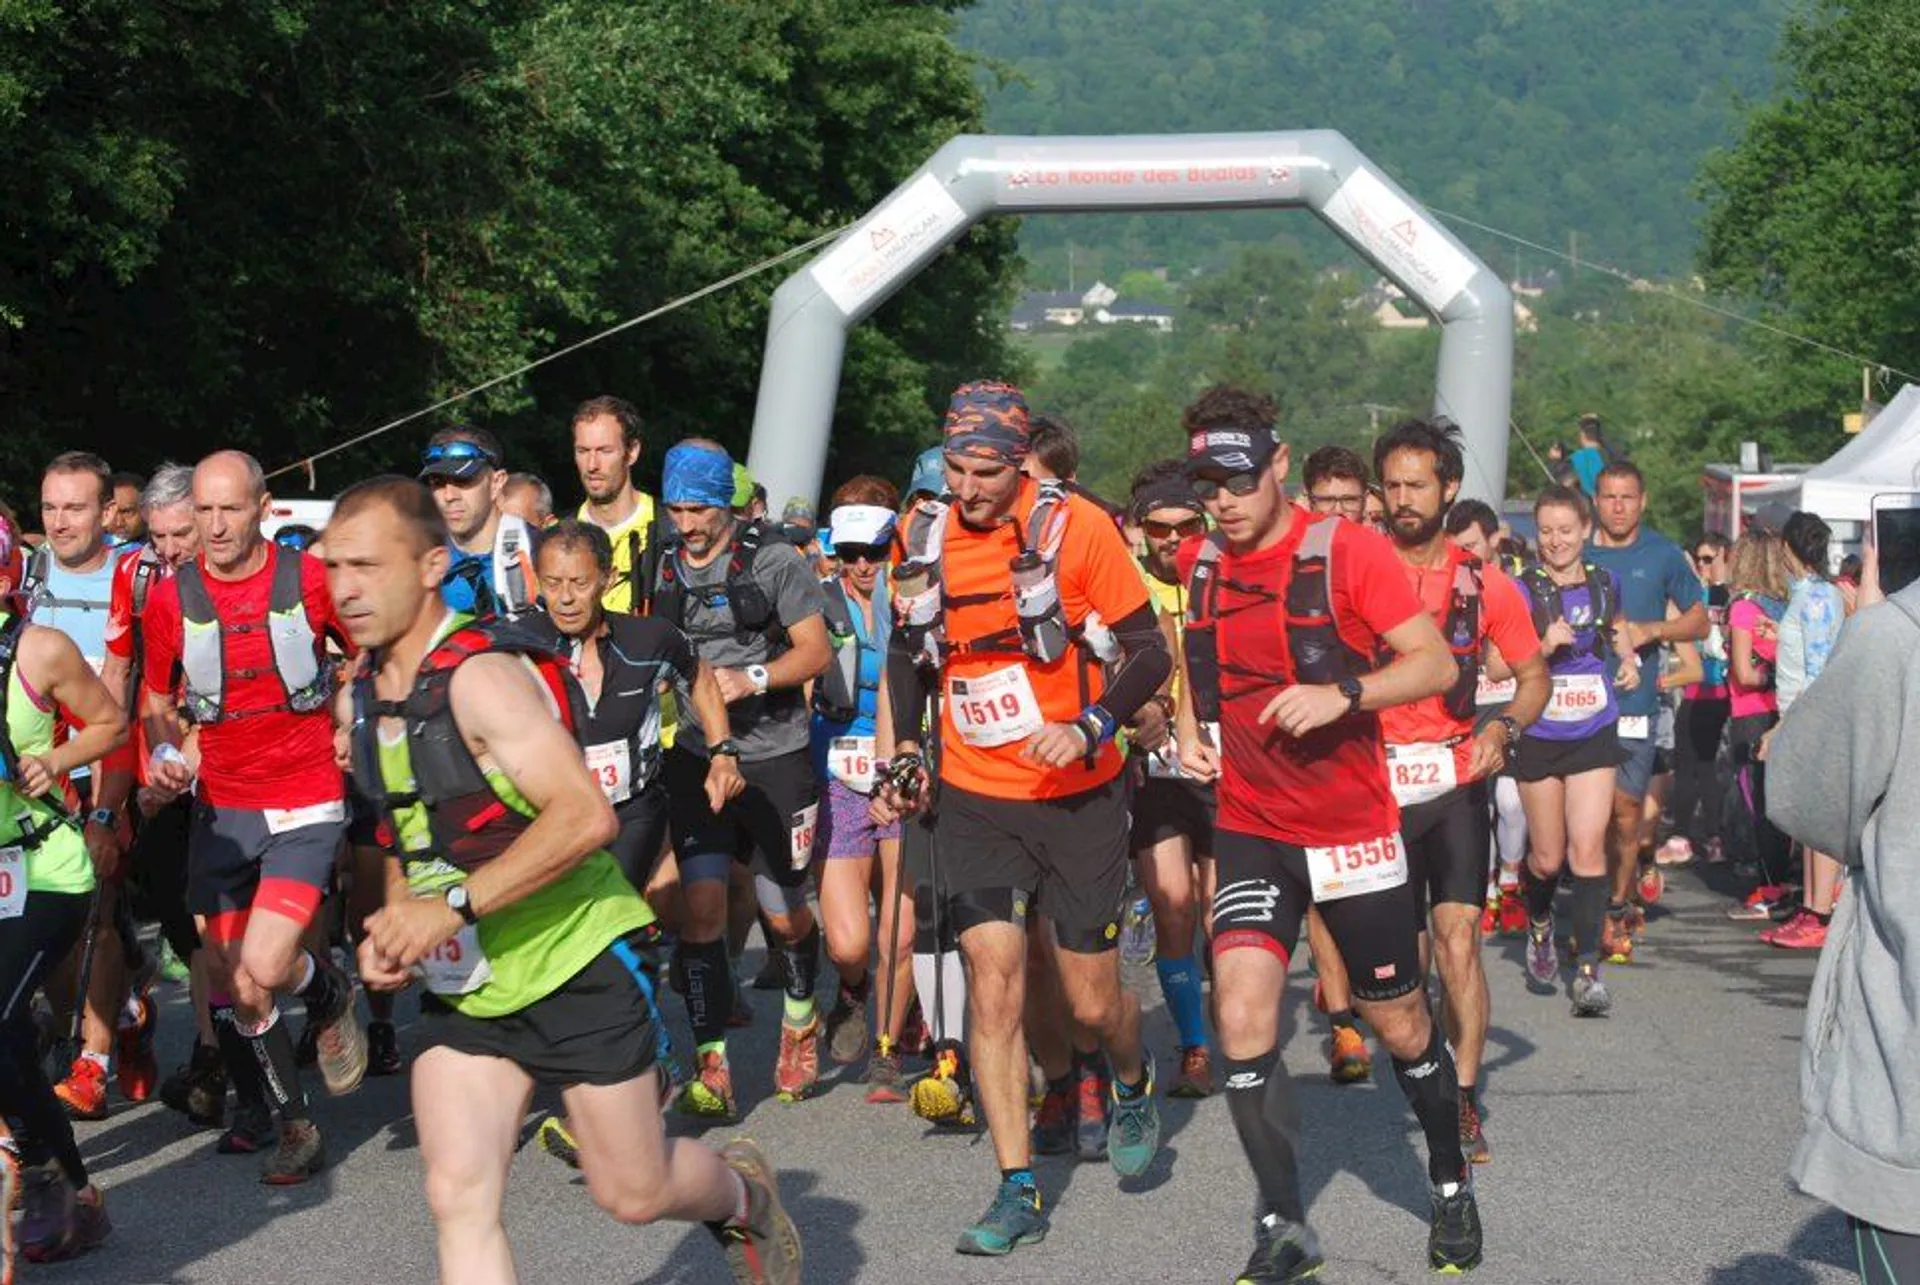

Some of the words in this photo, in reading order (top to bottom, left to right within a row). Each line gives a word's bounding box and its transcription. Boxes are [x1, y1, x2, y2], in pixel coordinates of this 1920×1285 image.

[1068, 164, 1136, 185] Ronde
[1142, 164, 1179, 184] des
[960, 693, 1020, 725] 1519
[1555, 692, 1597, 706] 1665
[1396, 763, 1440, 785] 822
[1325, 835, 1396, 873] 1556
